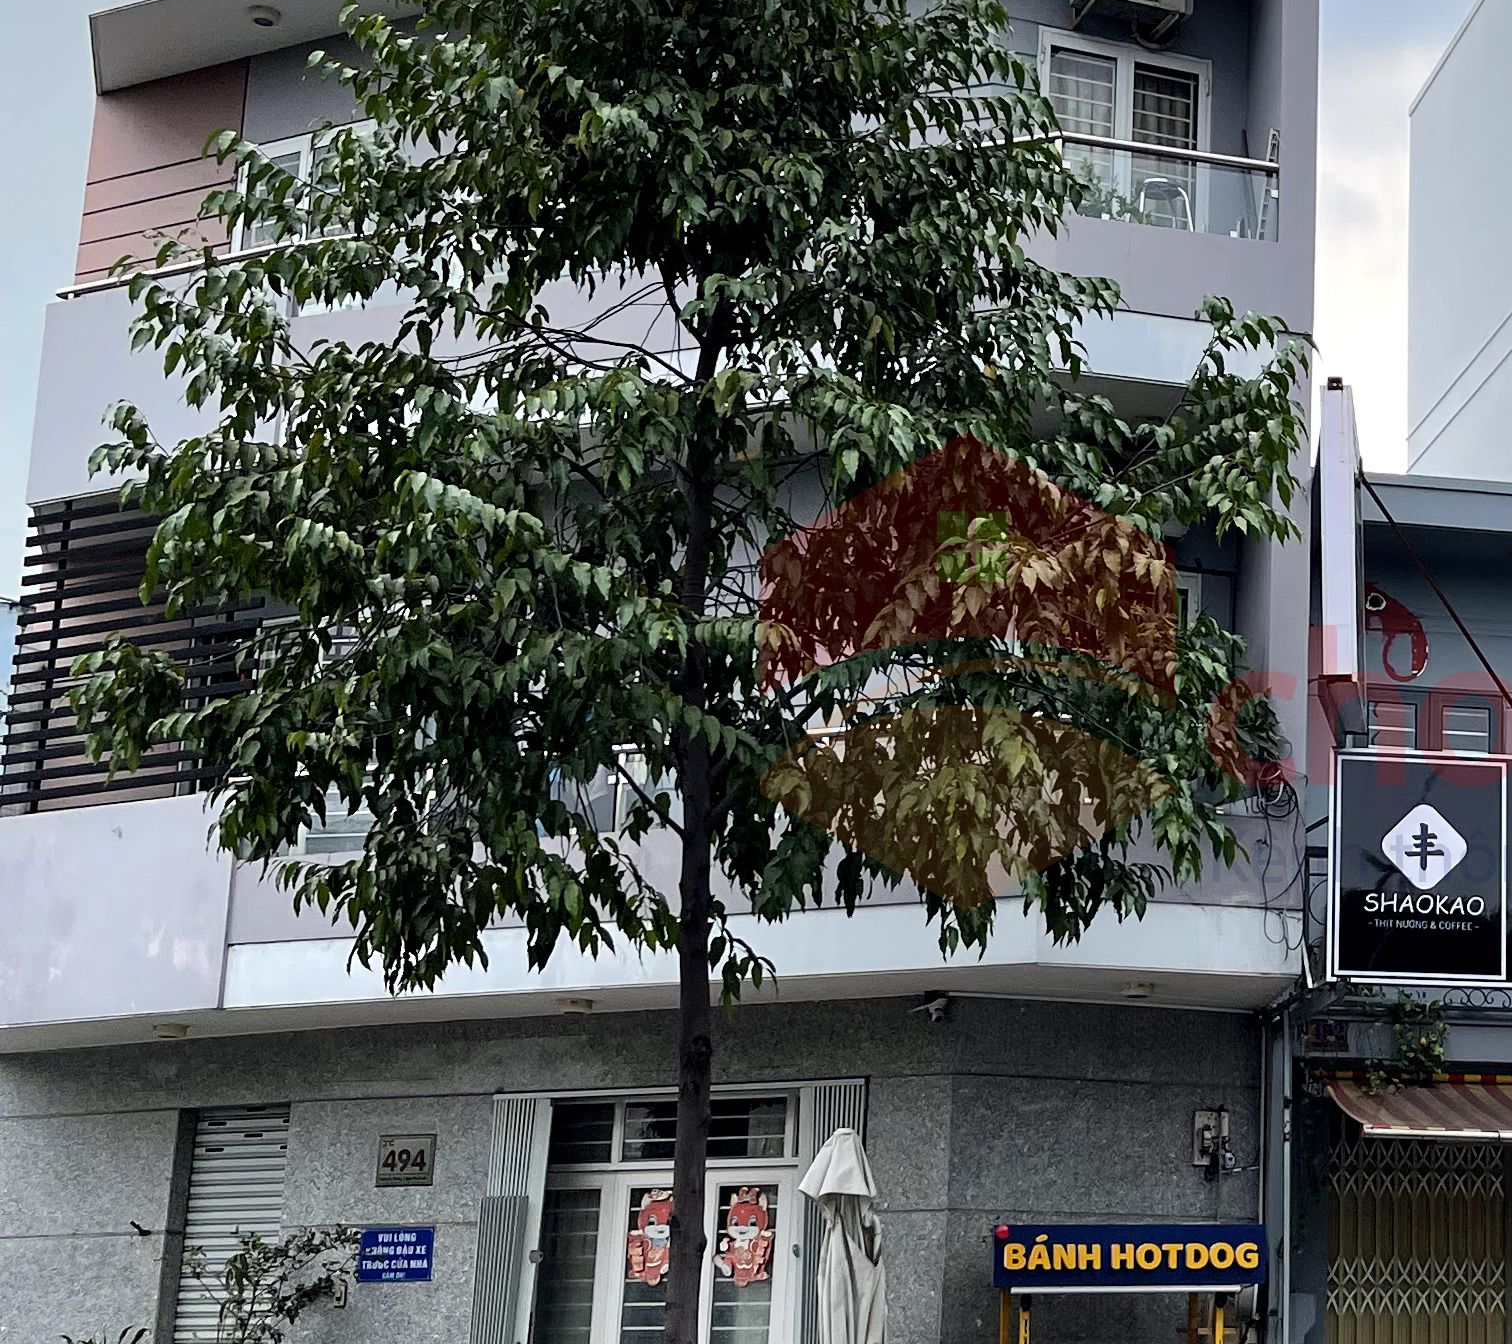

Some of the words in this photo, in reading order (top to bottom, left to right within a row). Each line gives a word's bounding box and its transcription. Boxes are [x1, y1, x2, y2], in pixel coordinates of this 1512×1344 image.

[1364, 893, 1485, 916] SHAOKAO
[1439, 921, 1472, 931] COFFEE
[383, 1149, 427, 1172] 494
[378, 1233, 392, 1243] VUI
[415, 1245, 426, 1254] XE
[1003, 1234, 1101, 1270] BÁNH
[1111, 1242, 1259, 1270] HOTDOG
